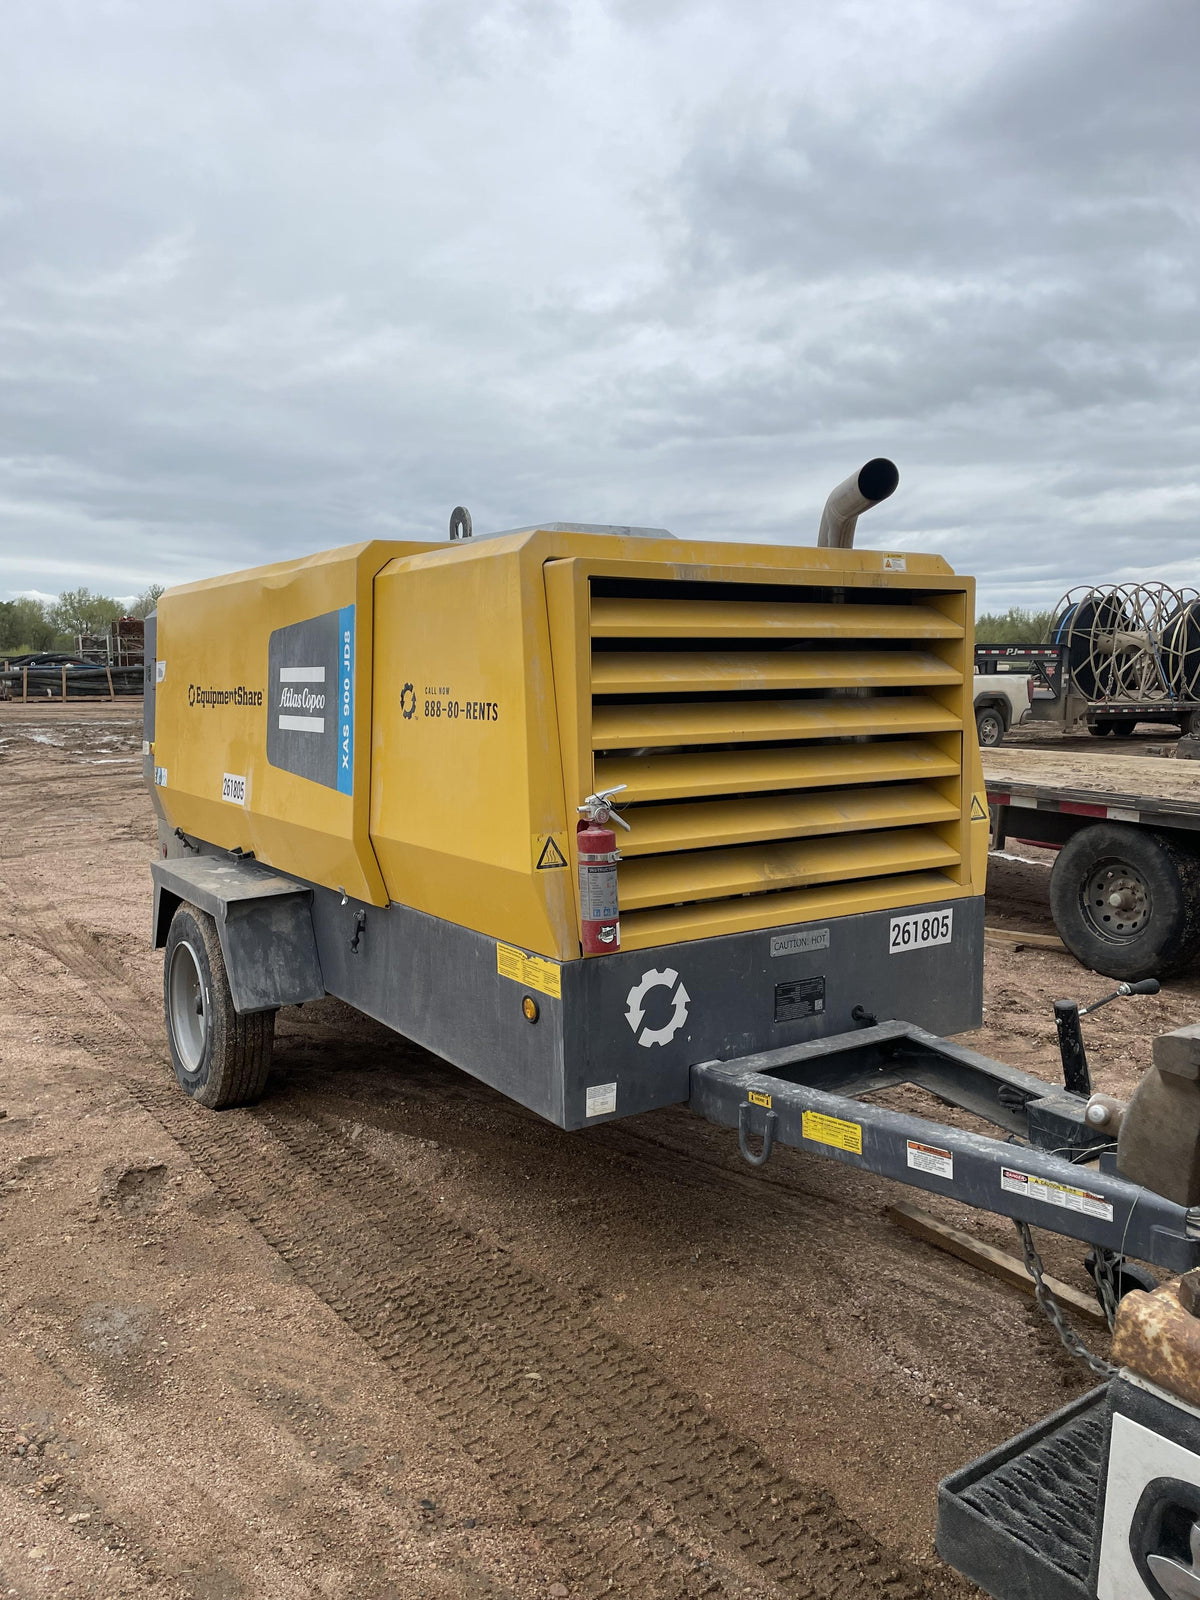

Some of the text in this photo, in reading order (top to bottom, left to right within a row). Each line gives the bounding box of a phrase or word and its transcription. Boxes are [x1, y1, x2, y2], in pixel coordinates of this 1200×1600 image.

[1005, 648, 1018, 656] PJ
[196, 686, 263, 708] EquipmentShare
[279, 687, 326, 713] Atlas Copco
[425, 686, 450, 695] CALL NOW
[424, 700, 499, 721] 888-80-RENTS
[342, 724, 350, 770] XAS
[223, 777, 245, 800] 261805
[811, 934, 827, 945] HOT
[891, 915, 950, 947] 261805
